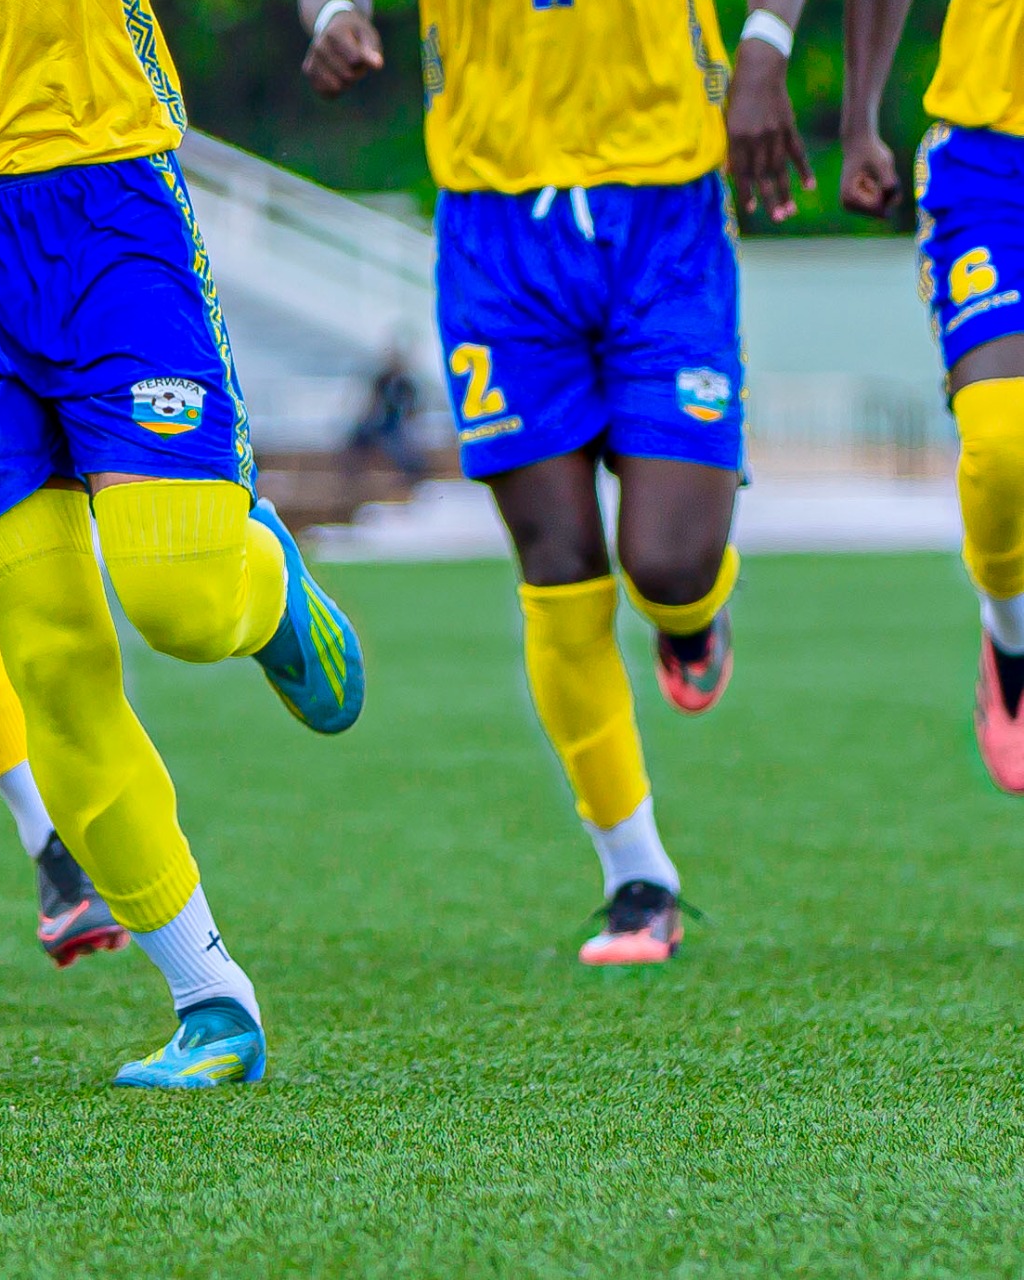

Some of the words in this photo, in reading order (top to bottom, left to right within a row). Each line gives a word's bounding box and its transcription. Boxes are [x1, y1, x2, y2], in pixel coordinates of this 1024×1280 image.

[950, 248, 997, 304] 6
[137, 377, 200, 394] FERWAFA
[450, 343, 505, 419] 2
